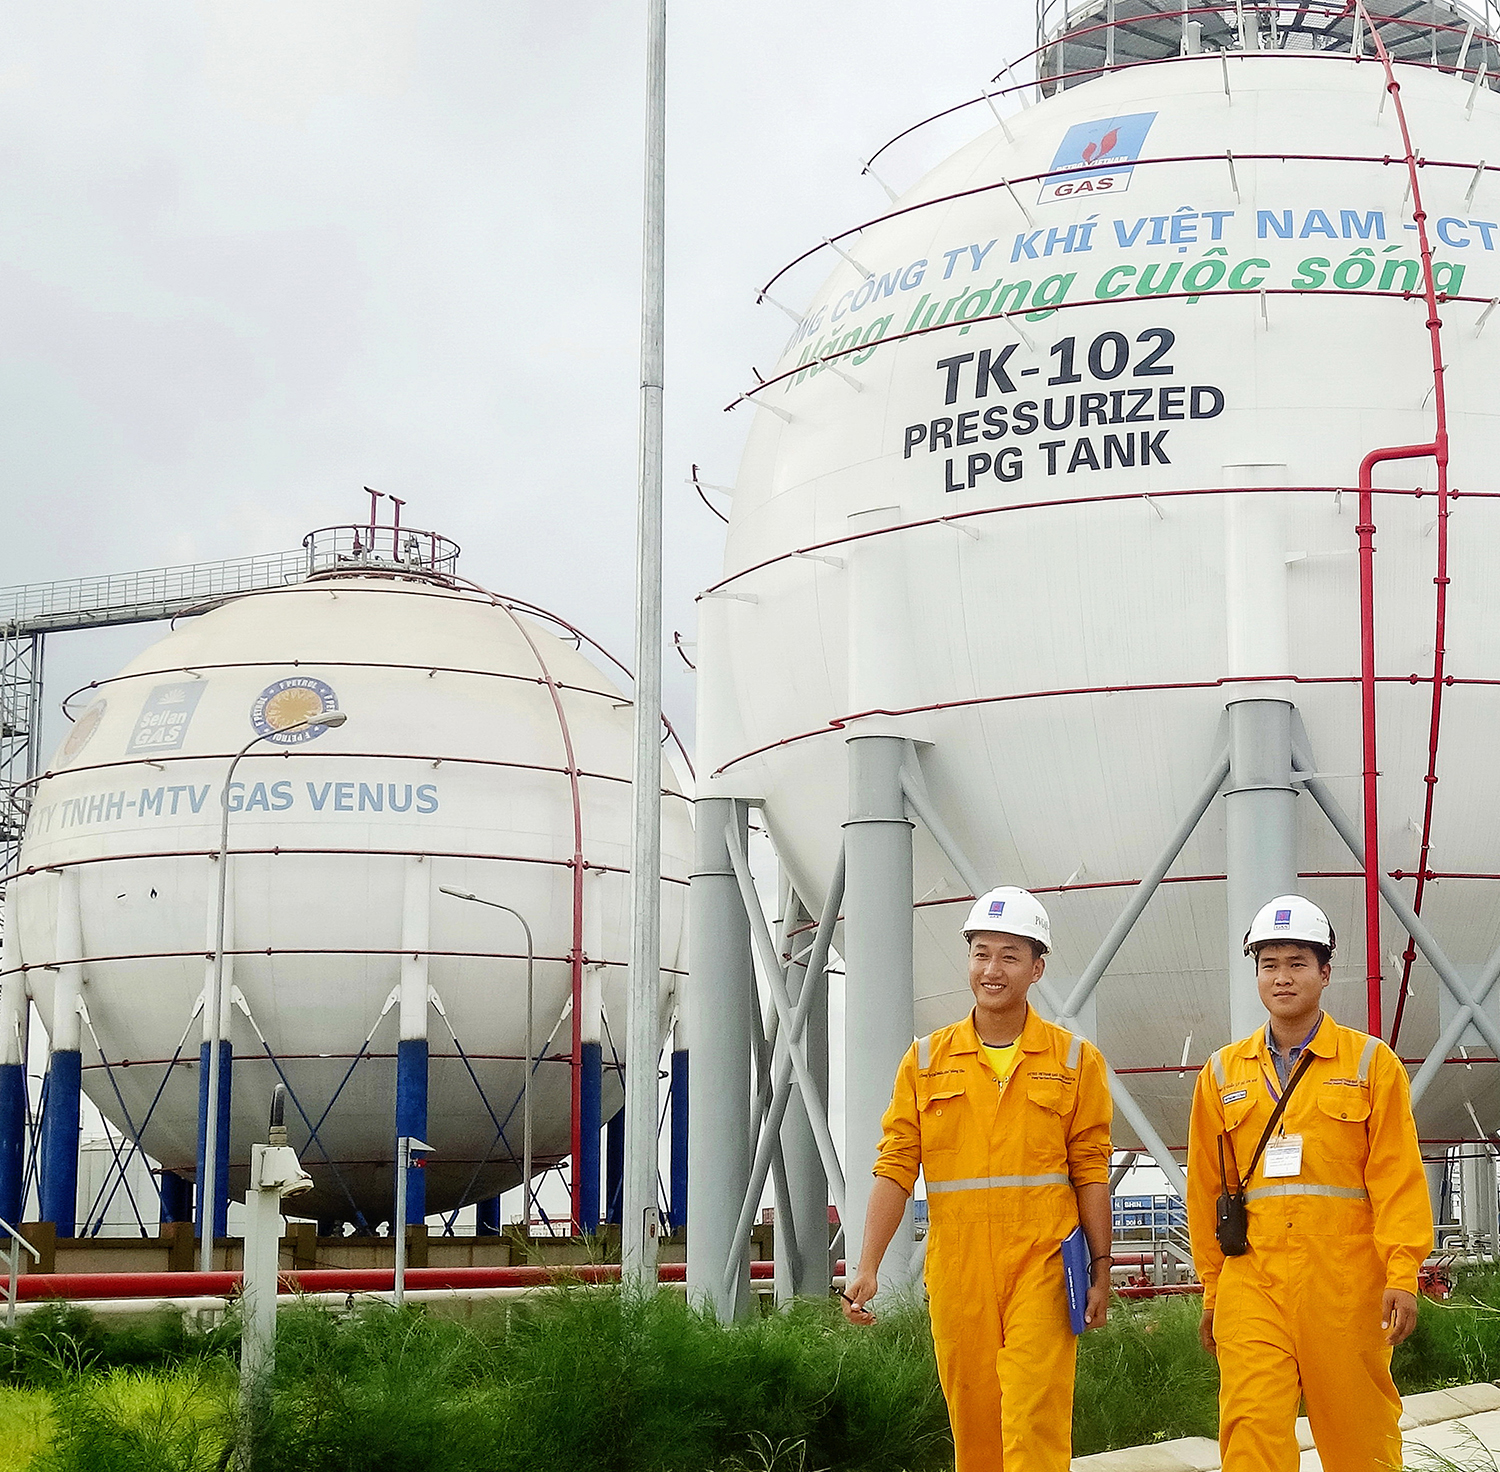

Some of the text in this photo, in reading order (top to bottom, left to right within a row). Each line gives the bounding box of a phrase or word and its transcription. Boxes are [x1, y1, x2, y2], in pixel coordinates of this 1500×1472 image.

[1054, 178, 1114, 196] GAS
[831, 258, 928, 323] CÔNG
[942, 238, 999, 280] TY
[1010, 213, 1099, 263] KHÍ
[1113, 206, 1235, 252] VIỆT
[1256, 209, 1387, 240] NAM
[784, 244, 1467, 394] Năng lượng cuộc sống
[936, 327, 1176, 406] TK-102
[903, 385, 1225, 460] PRESSURIZED
[944, 429, 1172, 493] LPG TANK
[134, 724, 183, 745] GAS
[61, 784, 211, 829] TNHH-MTV
[223, 780, 294, 813] GAS
[306, 781, 440, 814] VENUS
